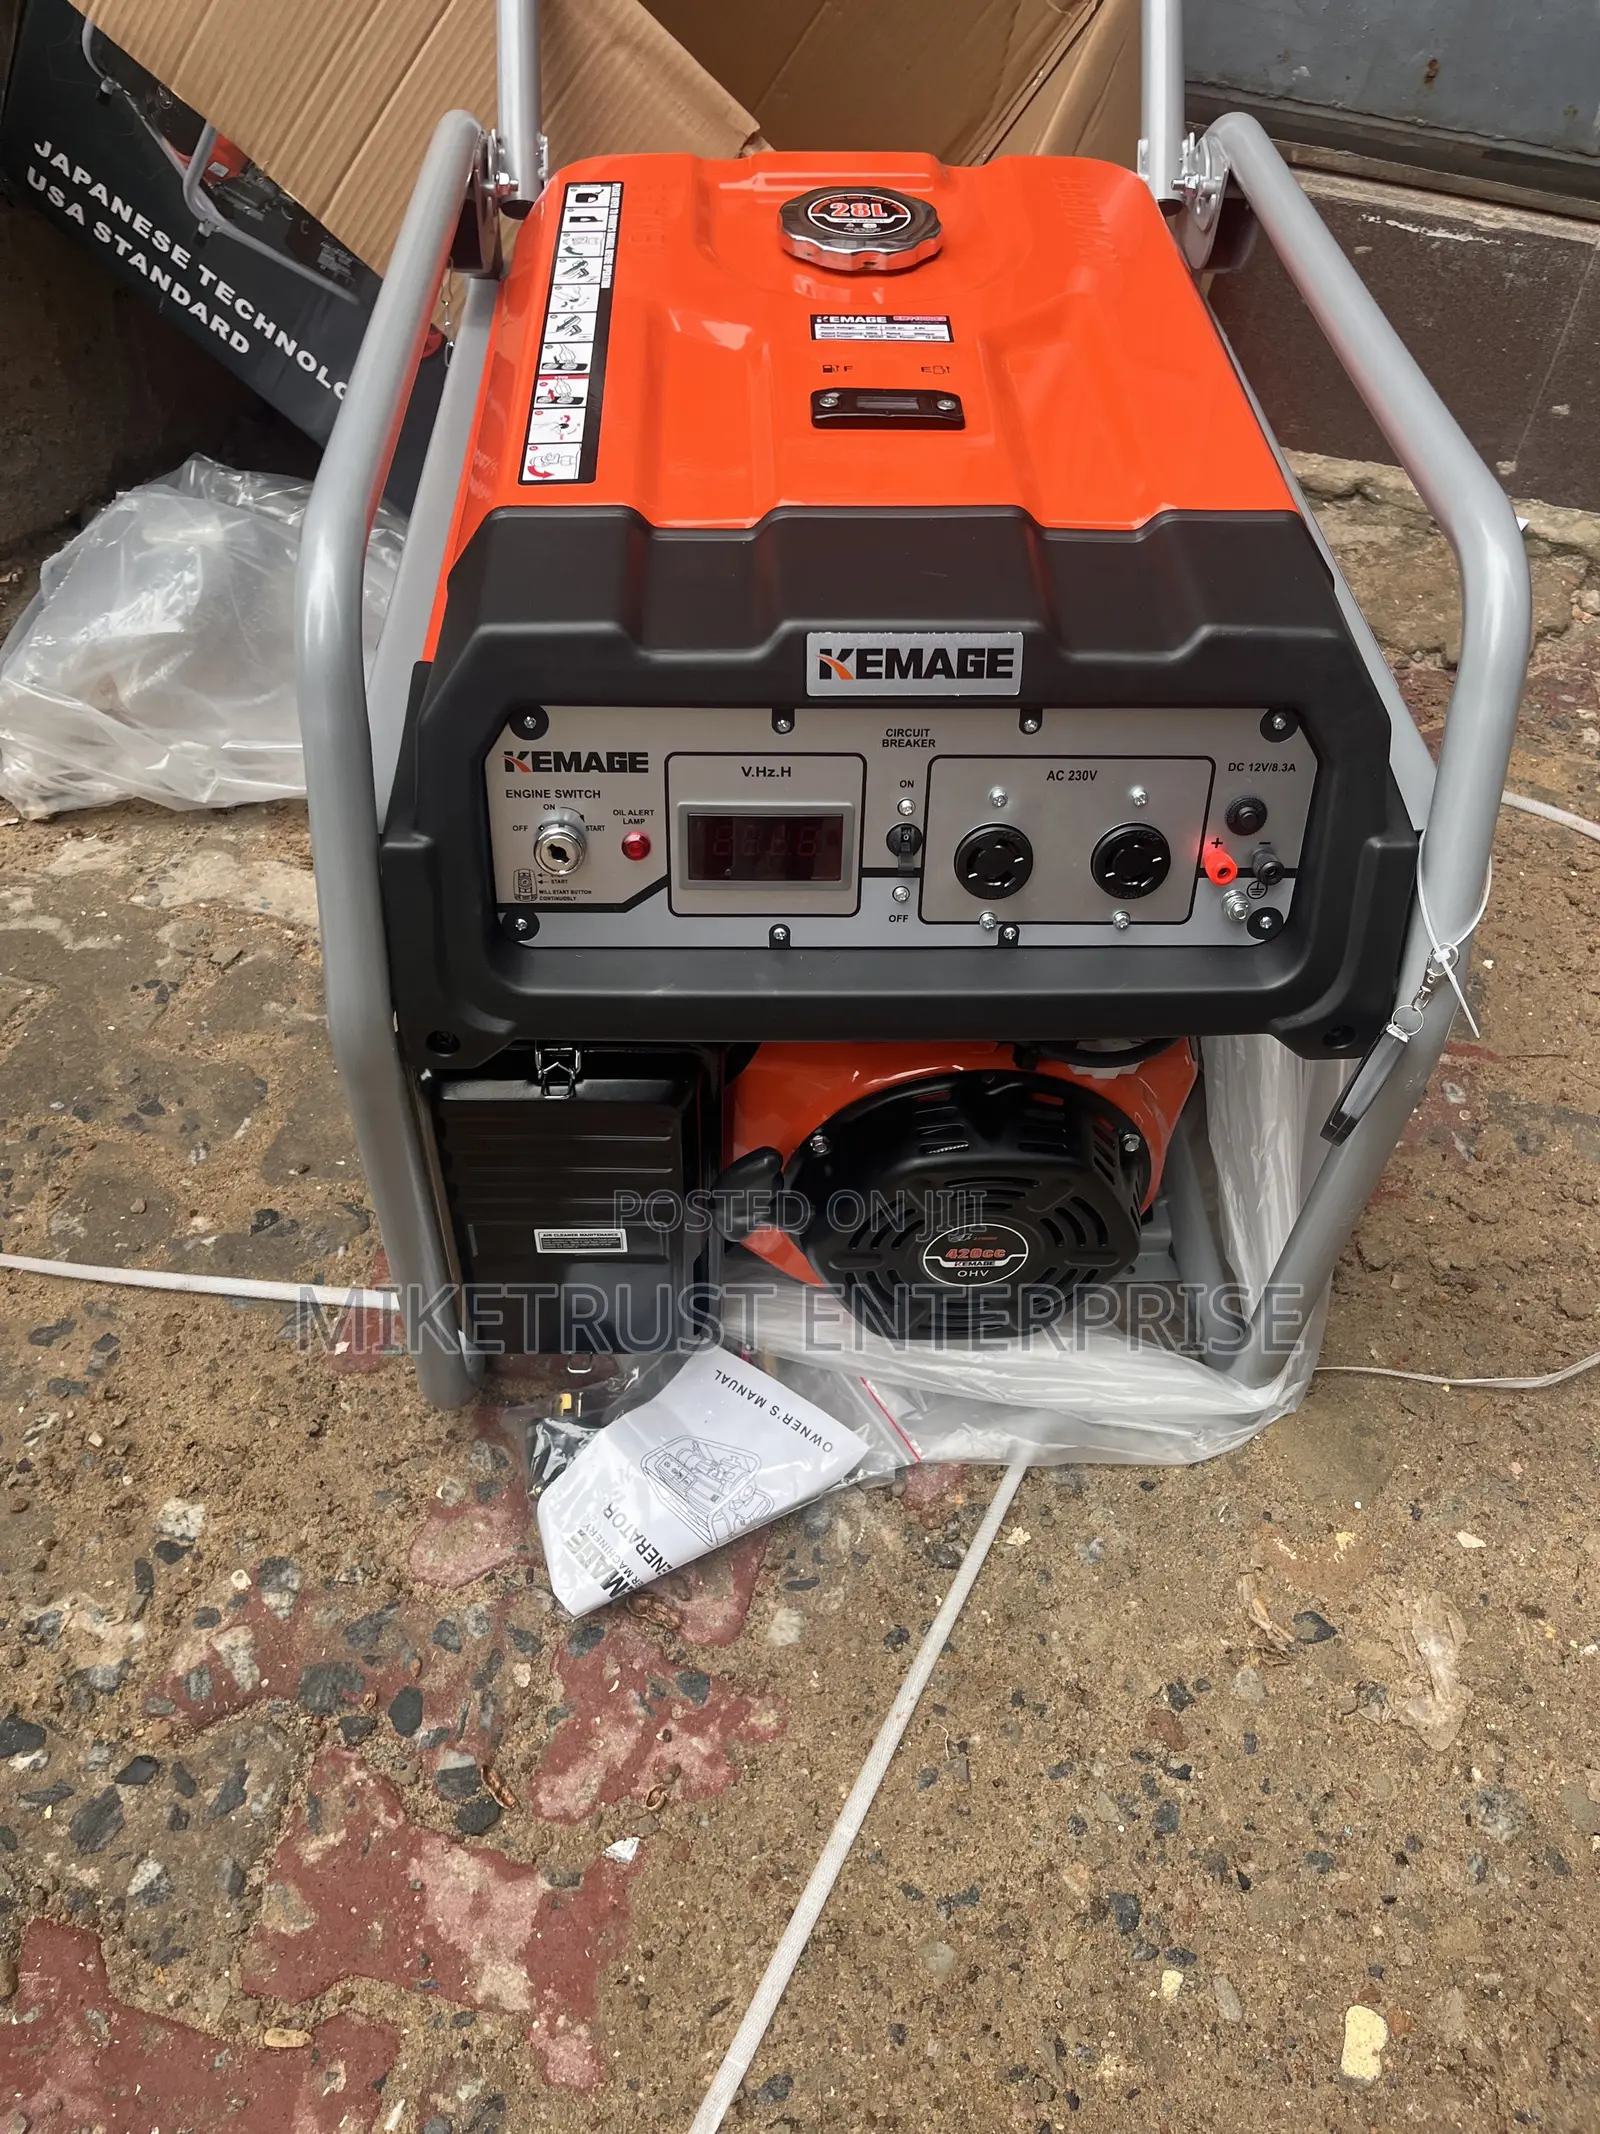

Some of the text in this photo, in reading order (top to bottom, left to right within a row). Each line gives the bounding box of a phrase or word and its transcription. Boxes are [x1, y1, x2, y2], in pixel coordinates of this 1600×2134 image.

[33, 140, 191, 270] JAPANESE
[828, 202, 889, 218] 28L
[26, 165, 86, 227] USA
[92, 220, 251, 355] STANDARD
[816, 315, 887, 324] KEMAGE
[816, 648, 1015, 681] KEMAGE
[885, 728, 931, 738] CIRCUIT
[881, 738, 936, 748] BREAKER
[502, 750, 649, 775] KEMAGE
[1227, 762, 1297, 772] DC 12V/8.3A
[740, 765, 792, 778] V.Hz.H
[1046, 769, 1098, 781] AC 230V
[899, 779, 915, 788] ON
[505, 789, 601, 799] ENGINE SWITCH
[543, 803, 556, 811] ON
[512, 824, 528, 832] OFF
[585, 824, 605, 832] START
[888, 914, 909, 923] OFF
[957, 1269, 989, 1278] OHV
[714, 1369, 834, 1453] OWNER'S MANUAL
[583, 1523, 635, 1579] MACHINERY
